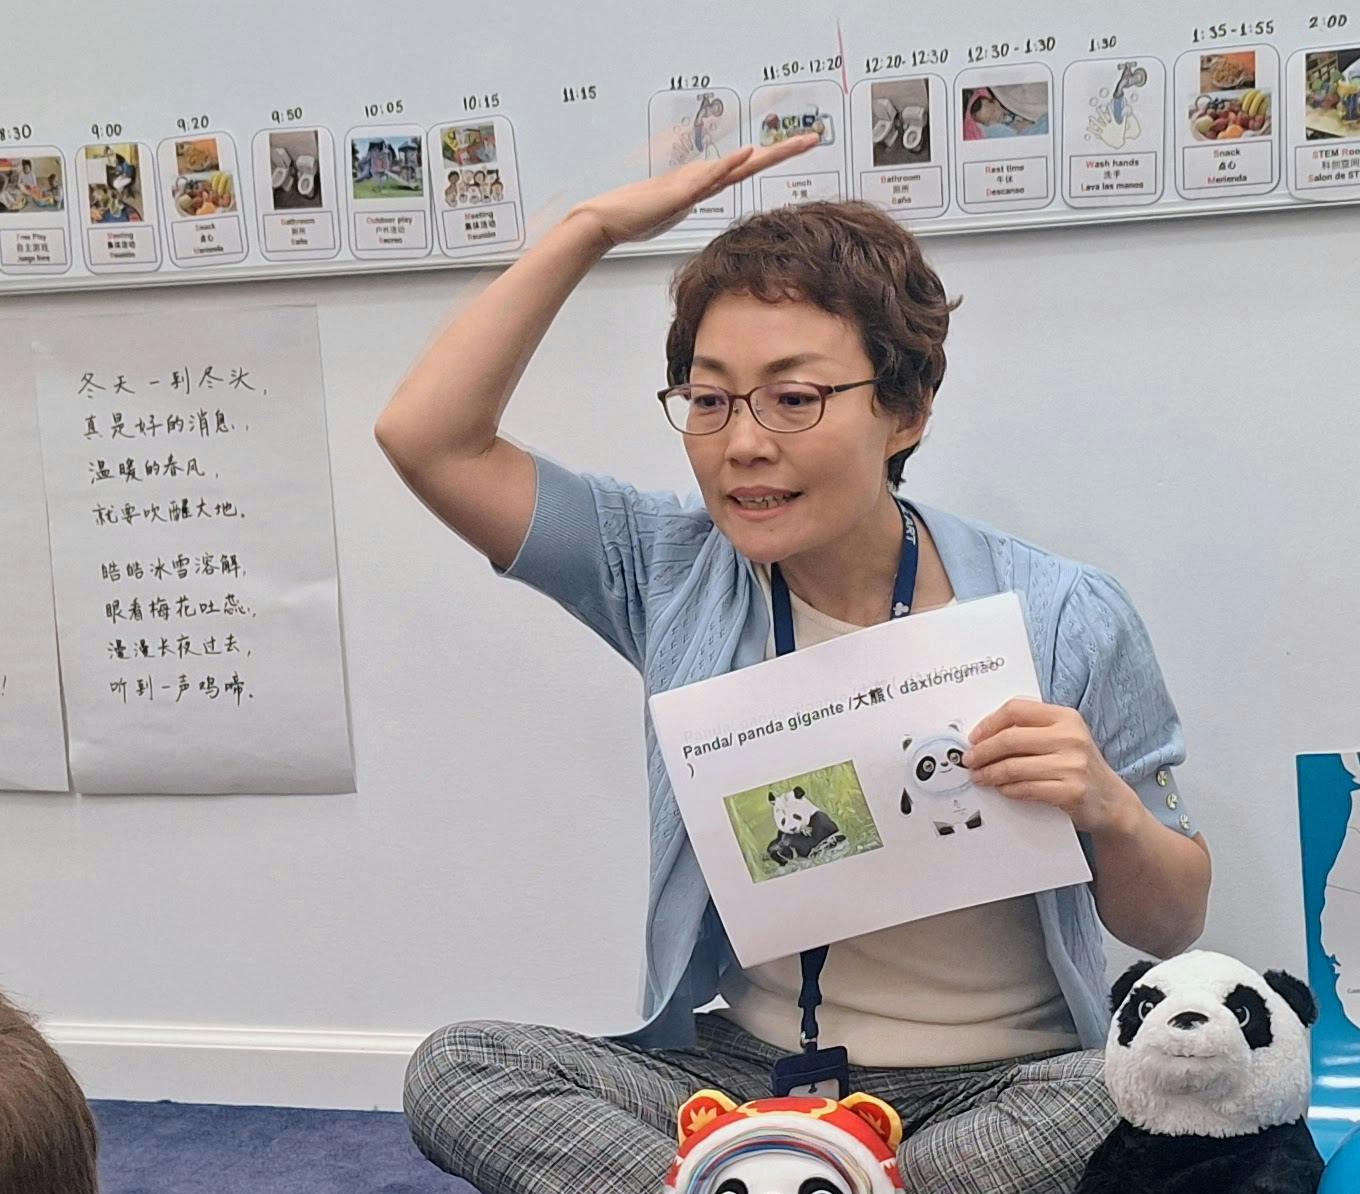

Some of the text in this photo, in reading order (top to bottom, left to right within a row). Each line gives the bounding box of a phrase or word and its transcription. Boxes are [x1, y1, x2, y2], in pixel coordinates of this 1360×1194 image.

[1309, 14, 1348, 28] 2:00
[1089, 35, 1117, 52] 1:30
[670, 75, 711, 90] 11:20
[463, 93, 500, 111] 10:15
[563, 86, 597, 103] 11:15
[271, 107, 303, 124] 9:50
[365, 99, 404, 118] 10:05
[91, 123, 122, 139] 9:00
[177, 115, 210, 132] 9:20
[1312, 149, 1339, 159] STEM
[683, 732, 733, 759] Panda/
[737, 720, 784, 746] panda
[787, 703, 844, 731] gigante
